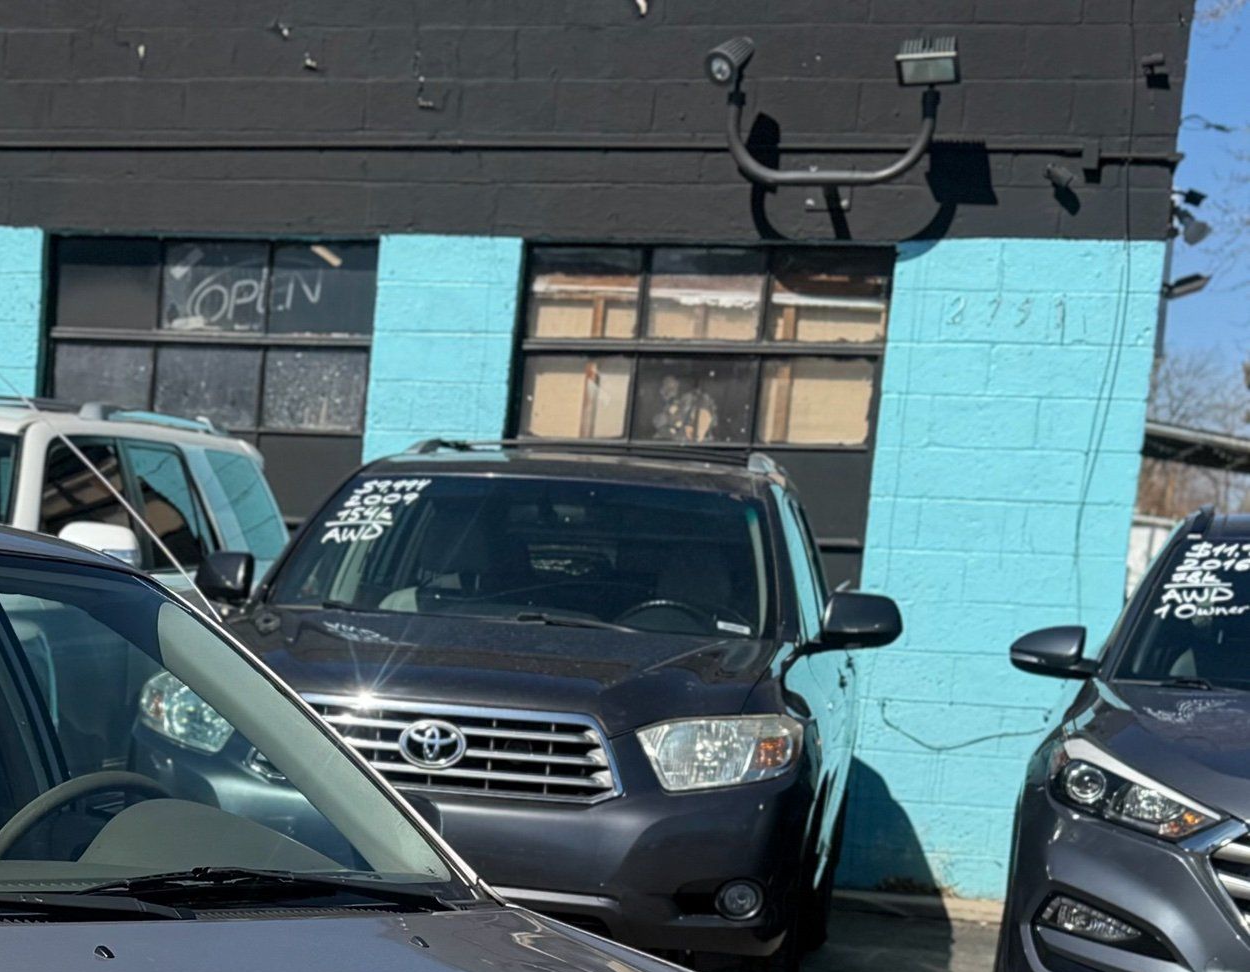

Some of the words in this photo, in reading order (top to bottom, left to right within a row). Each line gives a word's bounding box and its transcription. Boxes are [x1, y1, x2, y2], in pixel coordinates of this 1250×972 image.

[193, 267, 323, 323] OPEN
[344, 493, 420, 508] 2009
[321, 523, 384, 544] AWD
[1175, 558, 1250, 572] 2016
[1161, 587, 1235, 604] AWD
[1153, 604, 1171, 619] 1
[1174, 602, 1250, 619] Owner
